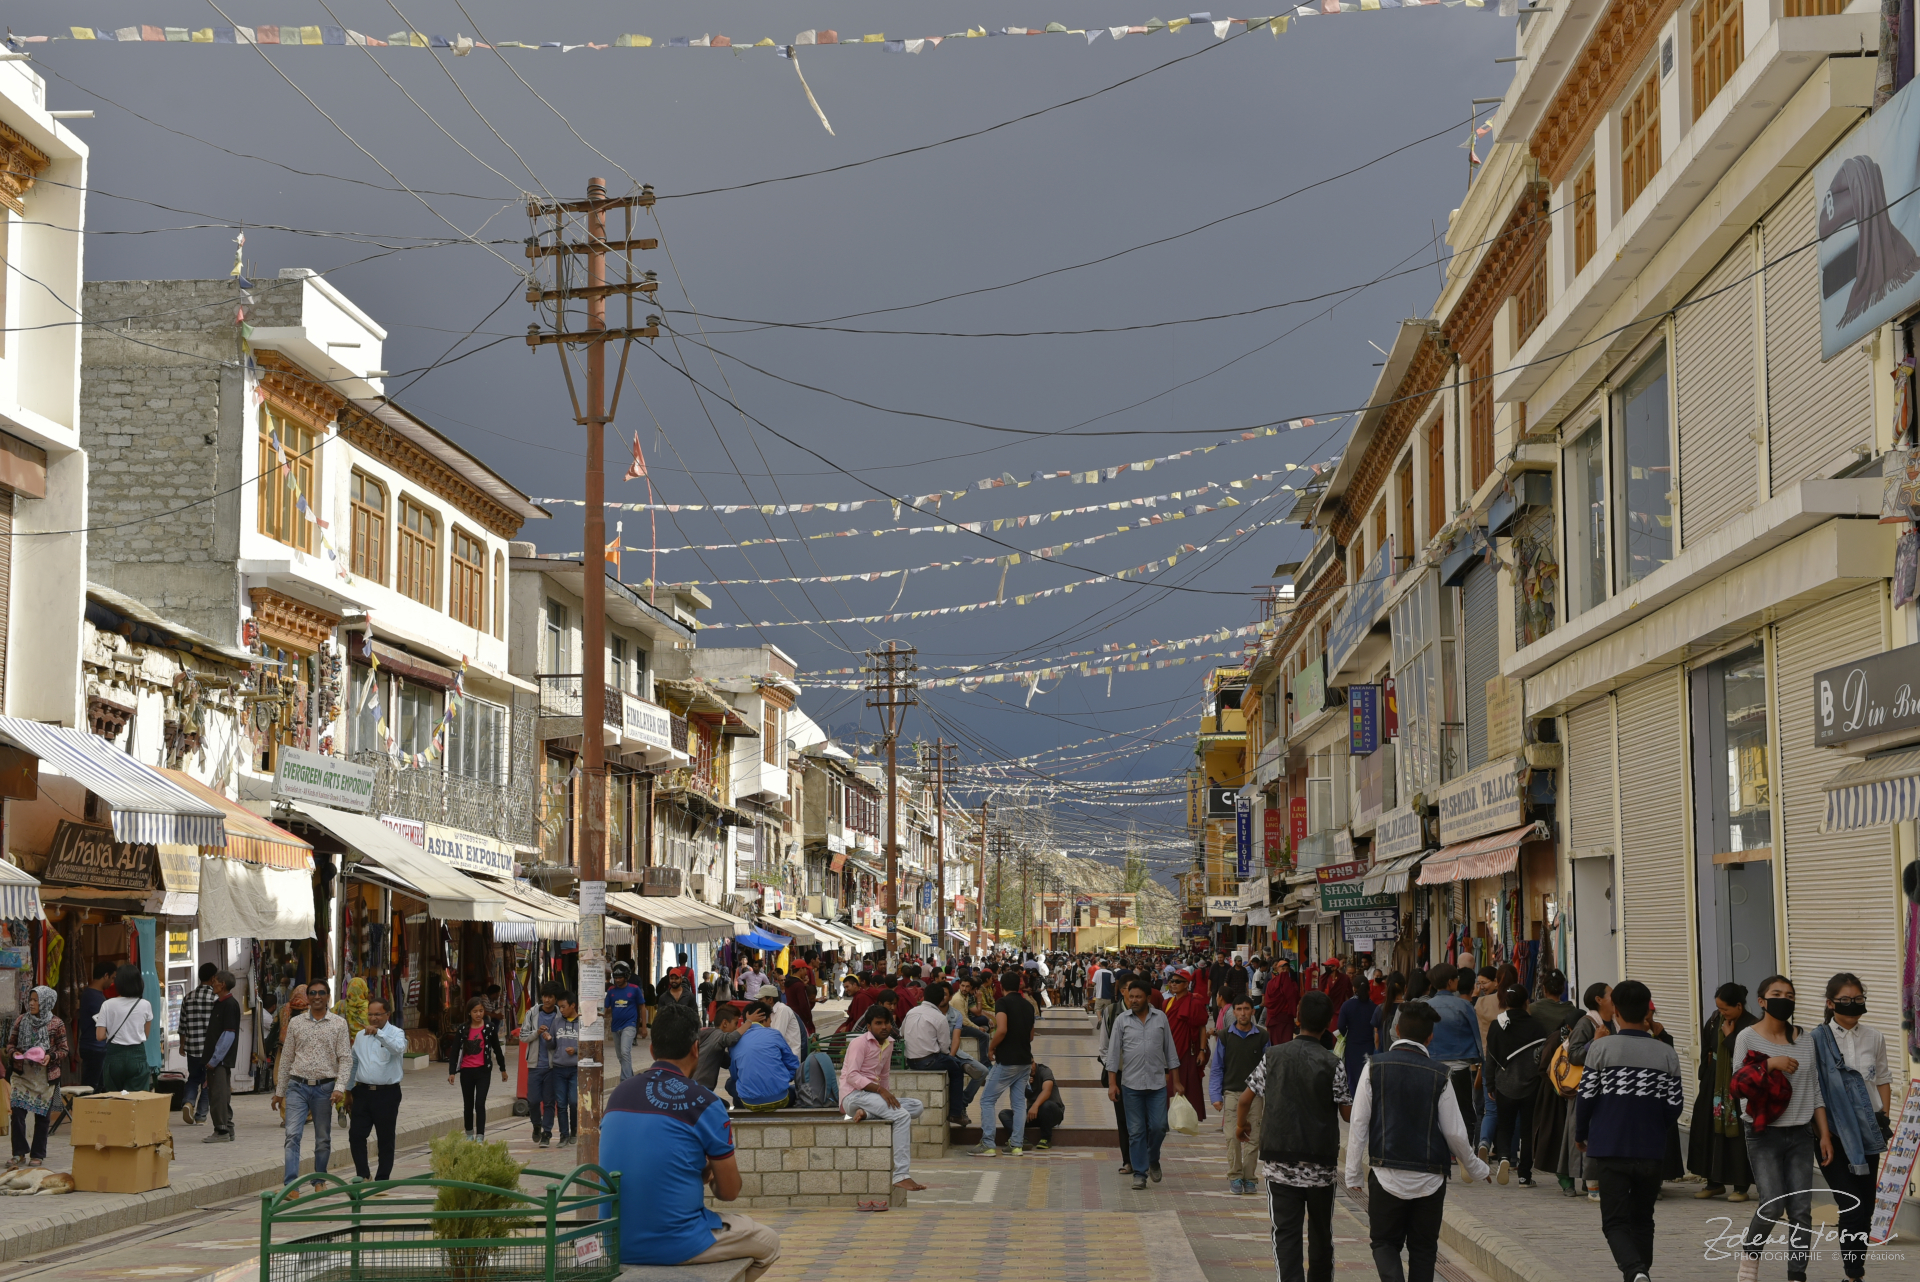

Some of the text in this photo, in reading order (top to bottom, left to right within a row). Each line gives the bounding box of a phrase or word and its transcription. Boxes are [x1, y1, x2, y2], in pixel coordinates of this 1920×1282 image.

[1842, 668, 1888, 732] Din
[282, 761, 322, 785] EVERGREEN
[323, 771, 341, 790] ARTS
[341, 775, 372, 797] EMPORIUM
[1481, 772, 1516, 807] PALACE
[1190, 779, 1198, 823] HIMALAYAN
[59, 827, 114, 869] Lhasa
[427, 836, 463, 860] ASIAN
[466, 845, 512, 871] EMPORIUM
[1329, 863, 1370, 878] PNB AT
[1328, 895, 1390, 908] HERITAGE
[672, 1102, 689, 1111] NYC
